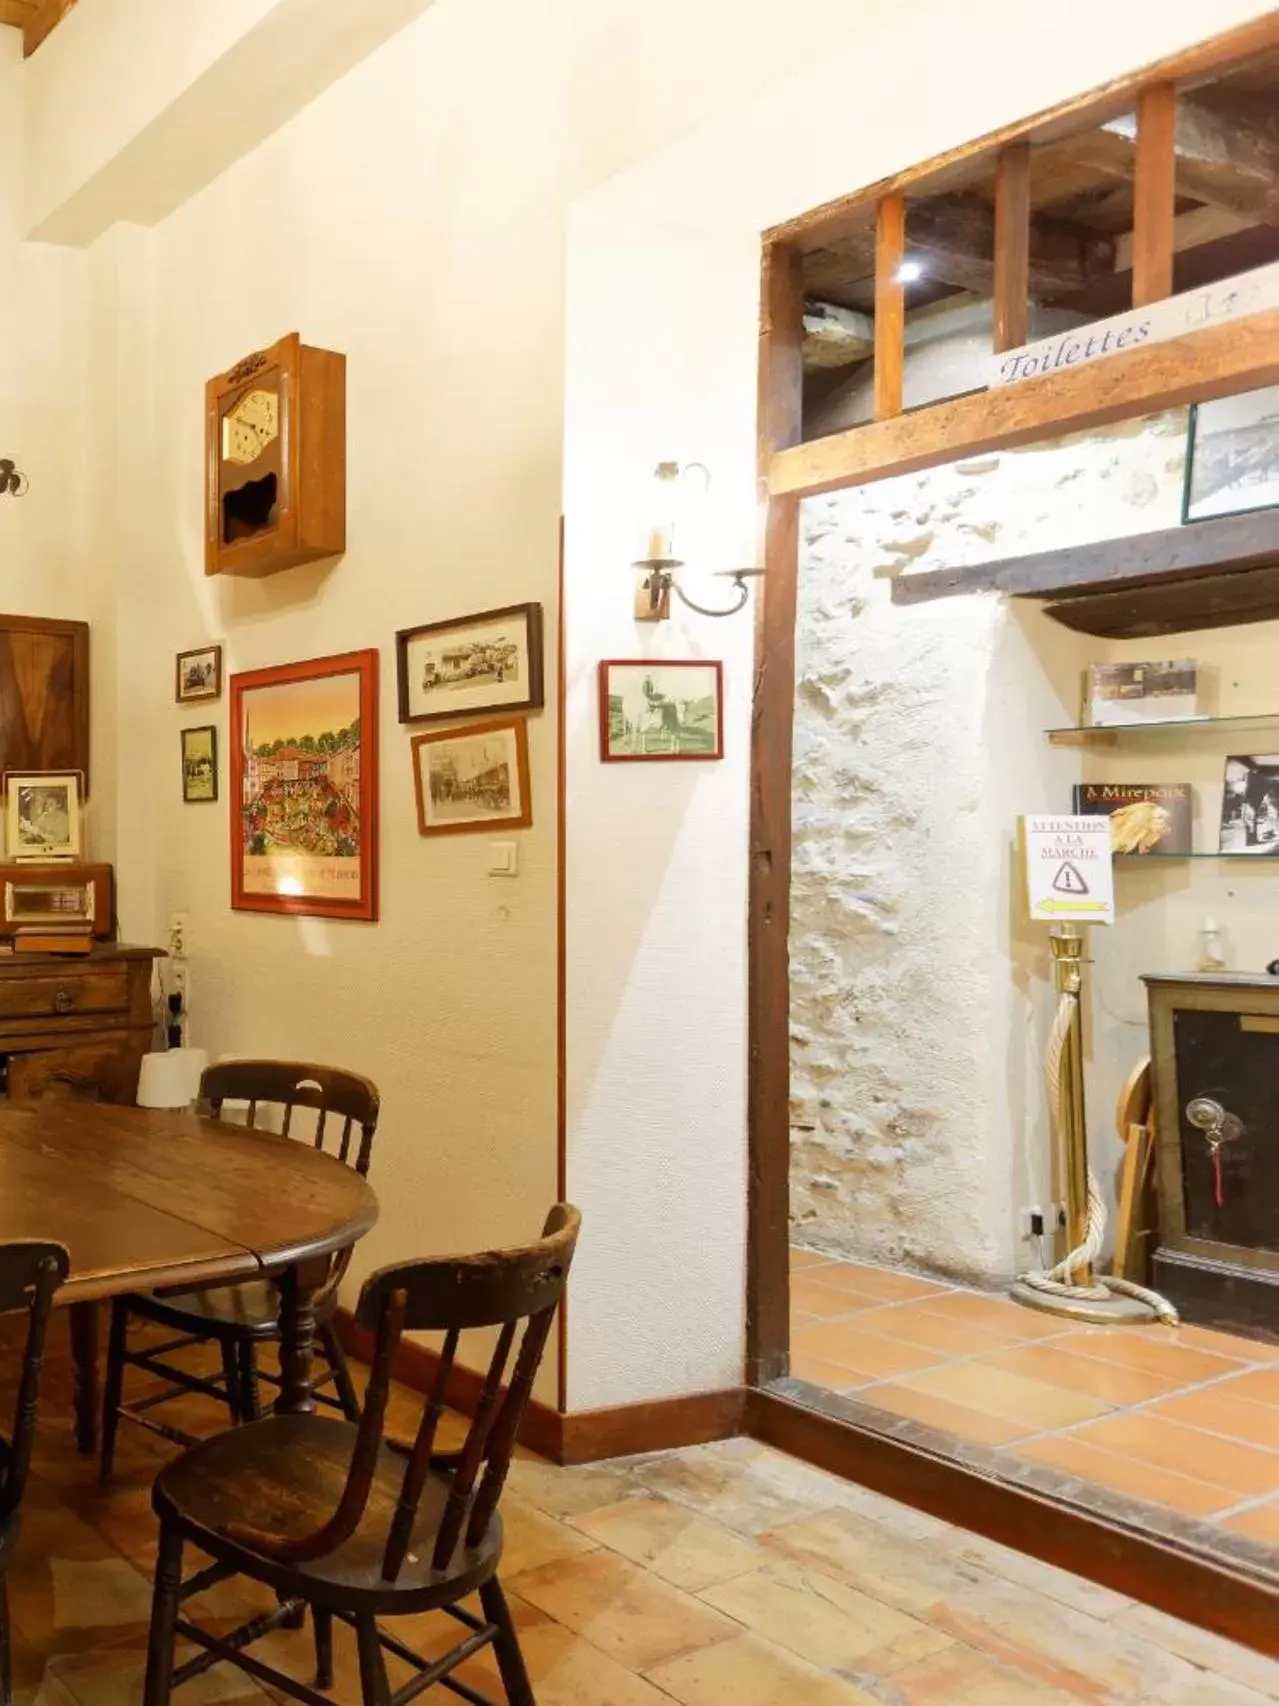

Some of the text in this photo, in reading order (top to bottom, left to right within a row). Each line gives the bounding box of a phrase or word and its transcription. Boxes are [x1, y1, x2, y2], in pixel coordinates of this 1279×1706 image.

[1000, 320, 1151, 383] Toilettes
[1102, 786, 1188, 801] Mirepoix
[1031, 820, 1107, 831] ATTENTION
[1041, 848, 1097, 860] MARCHE
